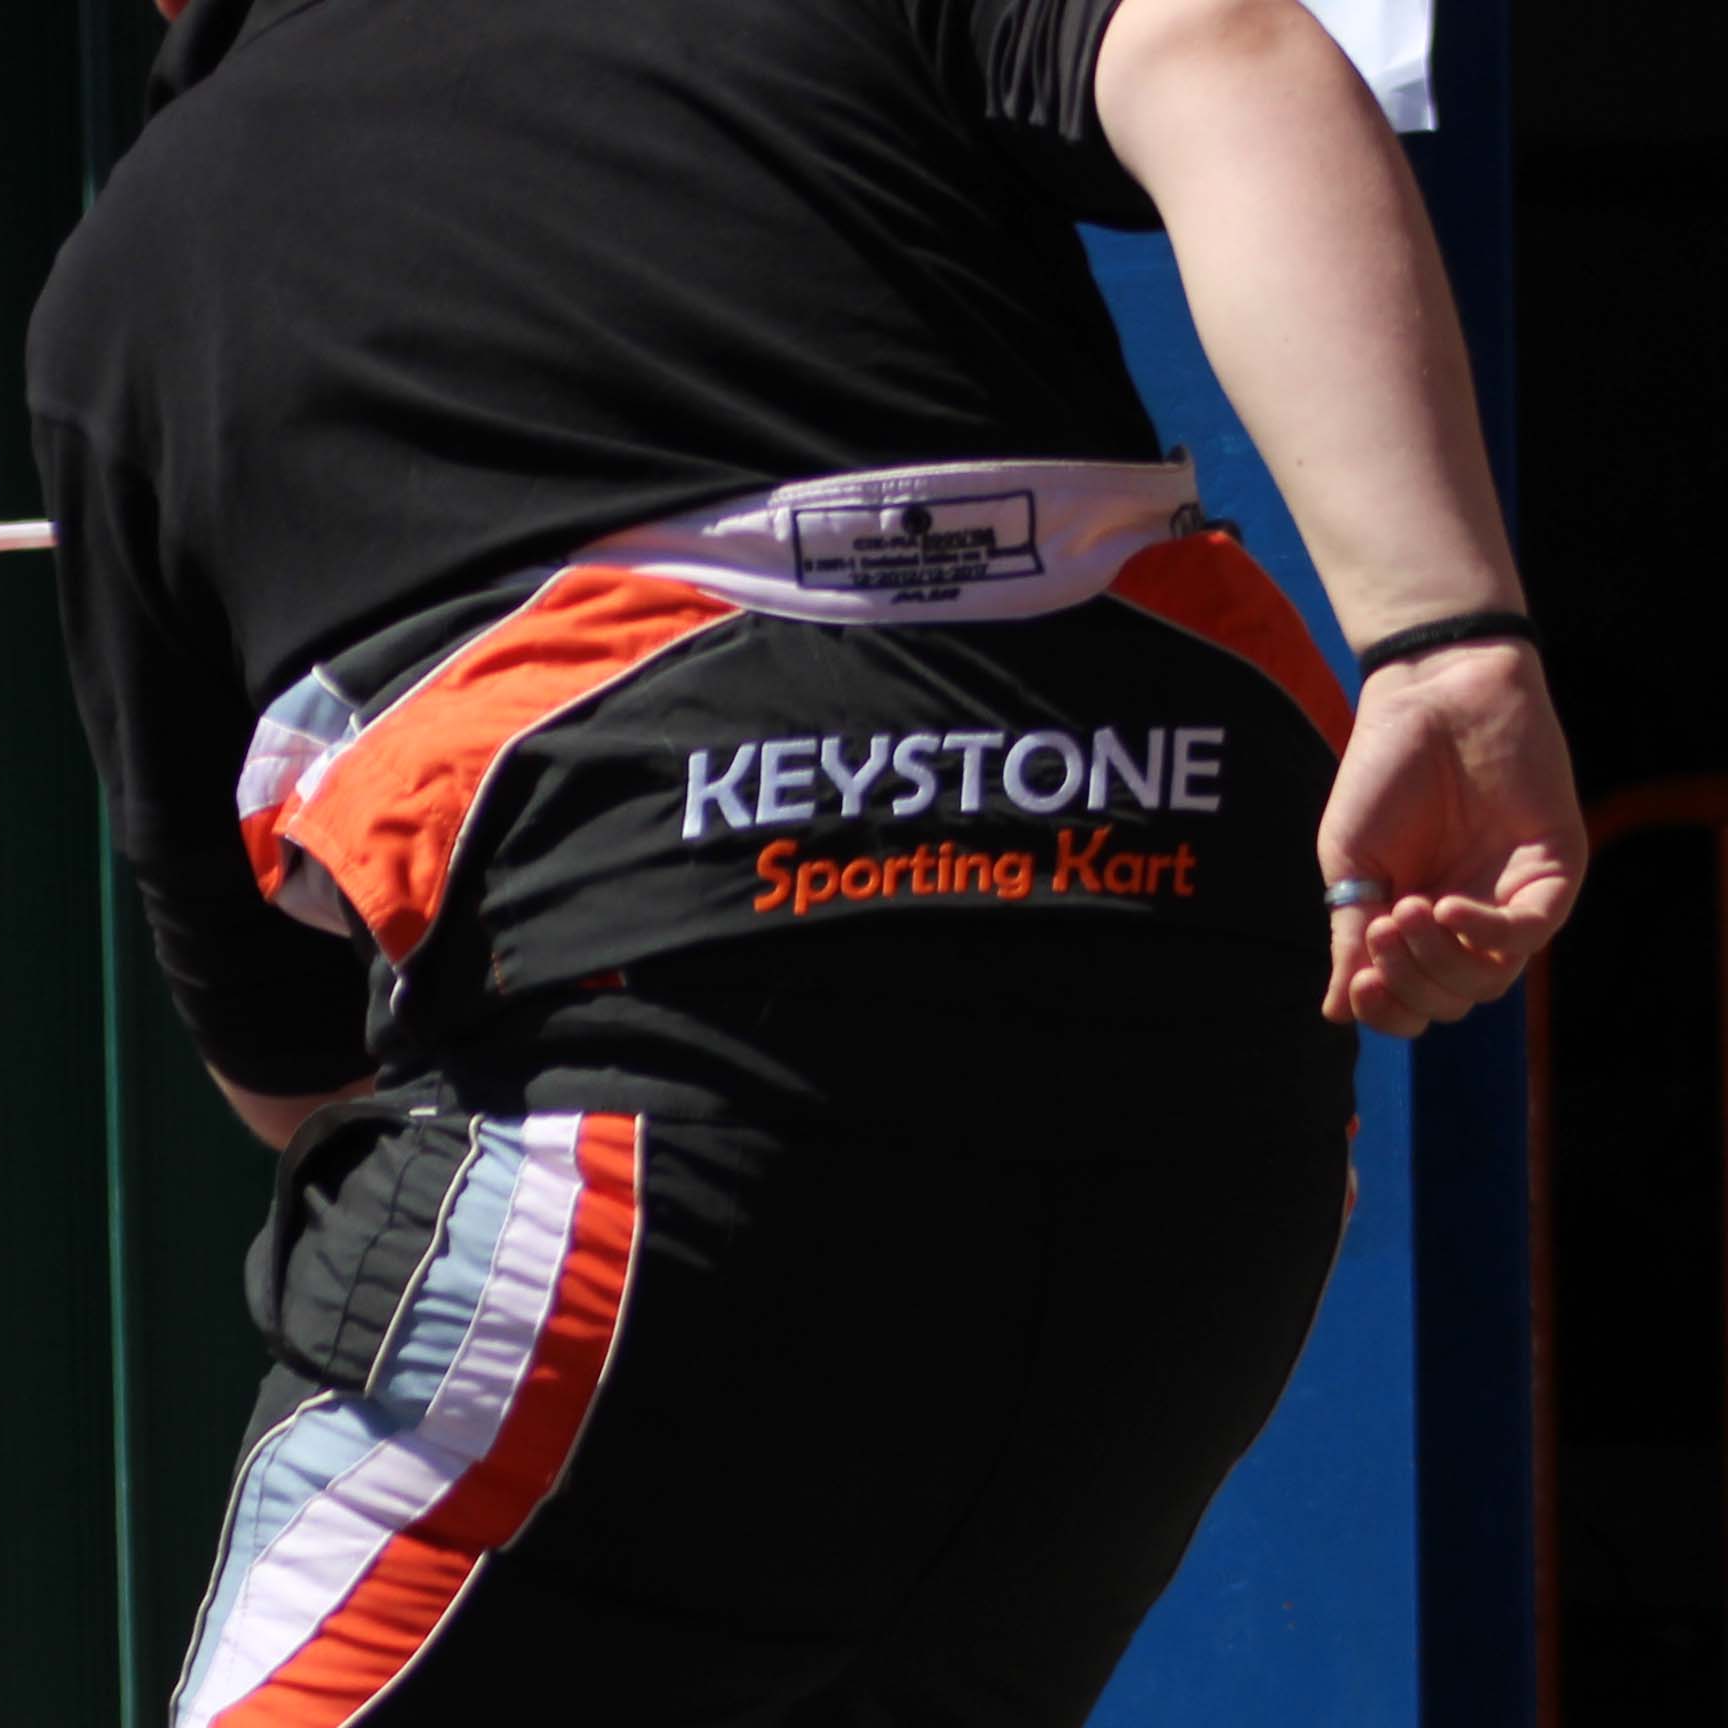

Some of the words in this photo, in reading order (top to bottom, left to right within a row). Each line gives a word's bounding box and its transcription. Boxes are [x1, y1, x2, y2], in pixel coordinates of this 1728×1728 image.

[680, 726, 1228, 841] KEYSTONE
[754, 838, 1034, 916] Sporting
[1054, 822, 1199, 897] Kart
